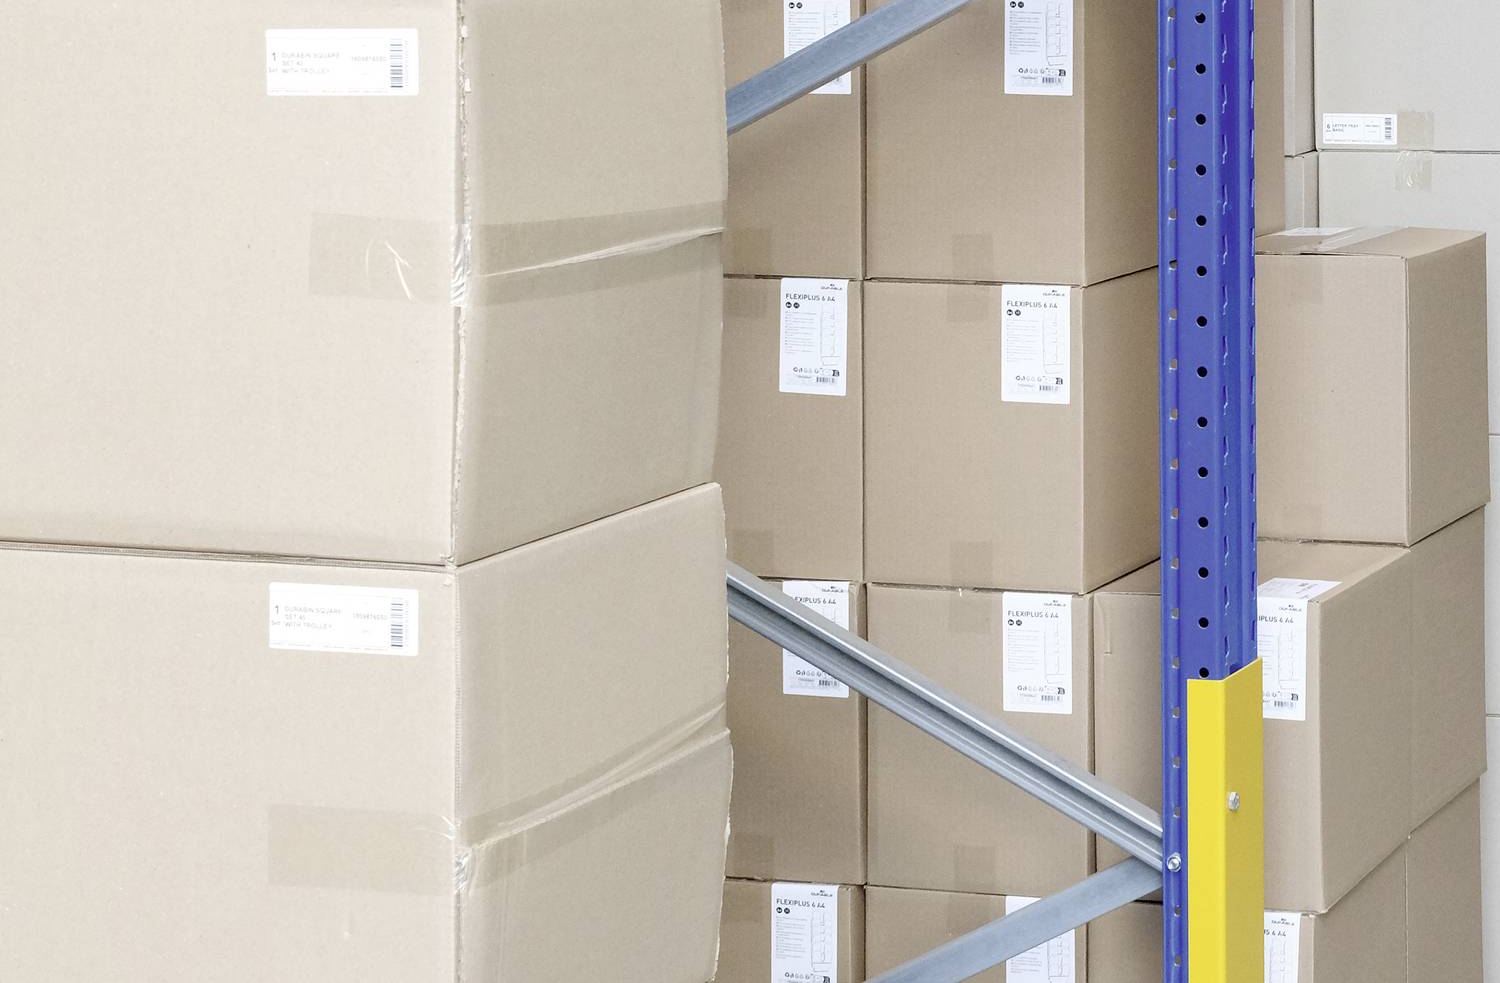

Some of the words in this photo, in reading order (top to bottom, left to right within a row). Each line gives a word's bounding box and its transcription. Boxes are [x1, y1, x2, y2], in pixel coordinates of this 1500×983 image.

[1006, 300, 1042, 308] FLEXIPLUS
[274, 605, 279, 614] 1
[1008, 610, 1043, 618] FLEXIPLUS
[303, 622, 332, 630] TROLLEY
[776, 898, 810, 907] FLEXIPLUS
